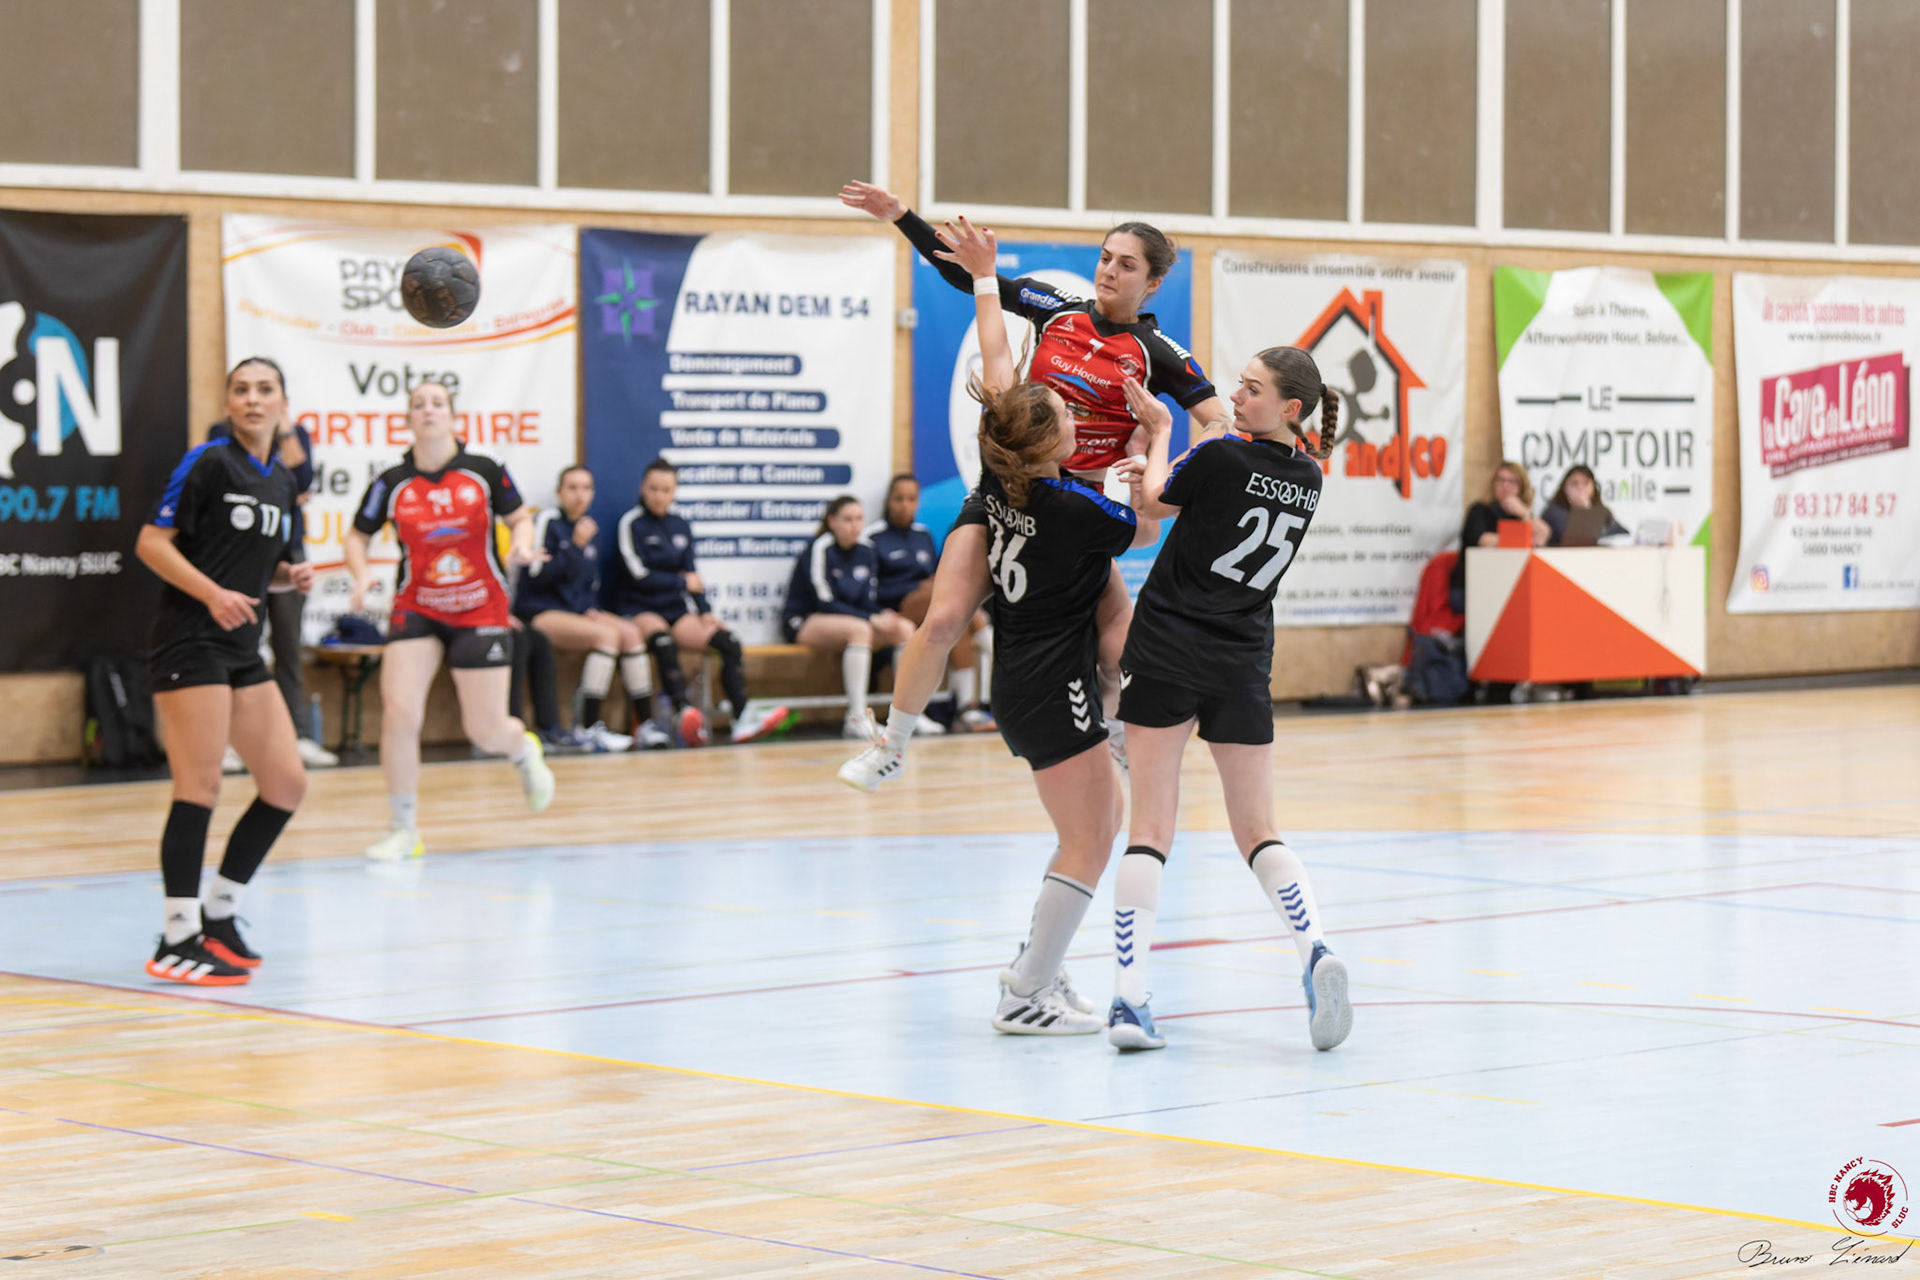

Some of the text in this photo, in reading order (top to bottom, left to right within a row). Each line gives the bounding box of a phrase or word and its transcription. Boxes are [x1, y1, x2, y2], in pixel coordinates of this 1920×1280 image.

[340, 259, 404, 280] PAY
[342, 285, 404, 312] SPO
[684, 292, 871, 319] RAYAN DEM 54
[1050, 354, 1072, 372] Guy
[1071, 364, 1112, 389] Hoquet
[1587, 386, 1612, 411] LE
[1774, 376, 1826, 448] Cave
[1838, 359, 1896, 432] Léon
[296, 412, 541, 445] ARTEAIRE
[677, 465, 738, 483] ocation
[0, 485, 120, 522] 90.7 FM
[259, 503, 281, 538] 17
[1210, 506, 1306, 592] 25
